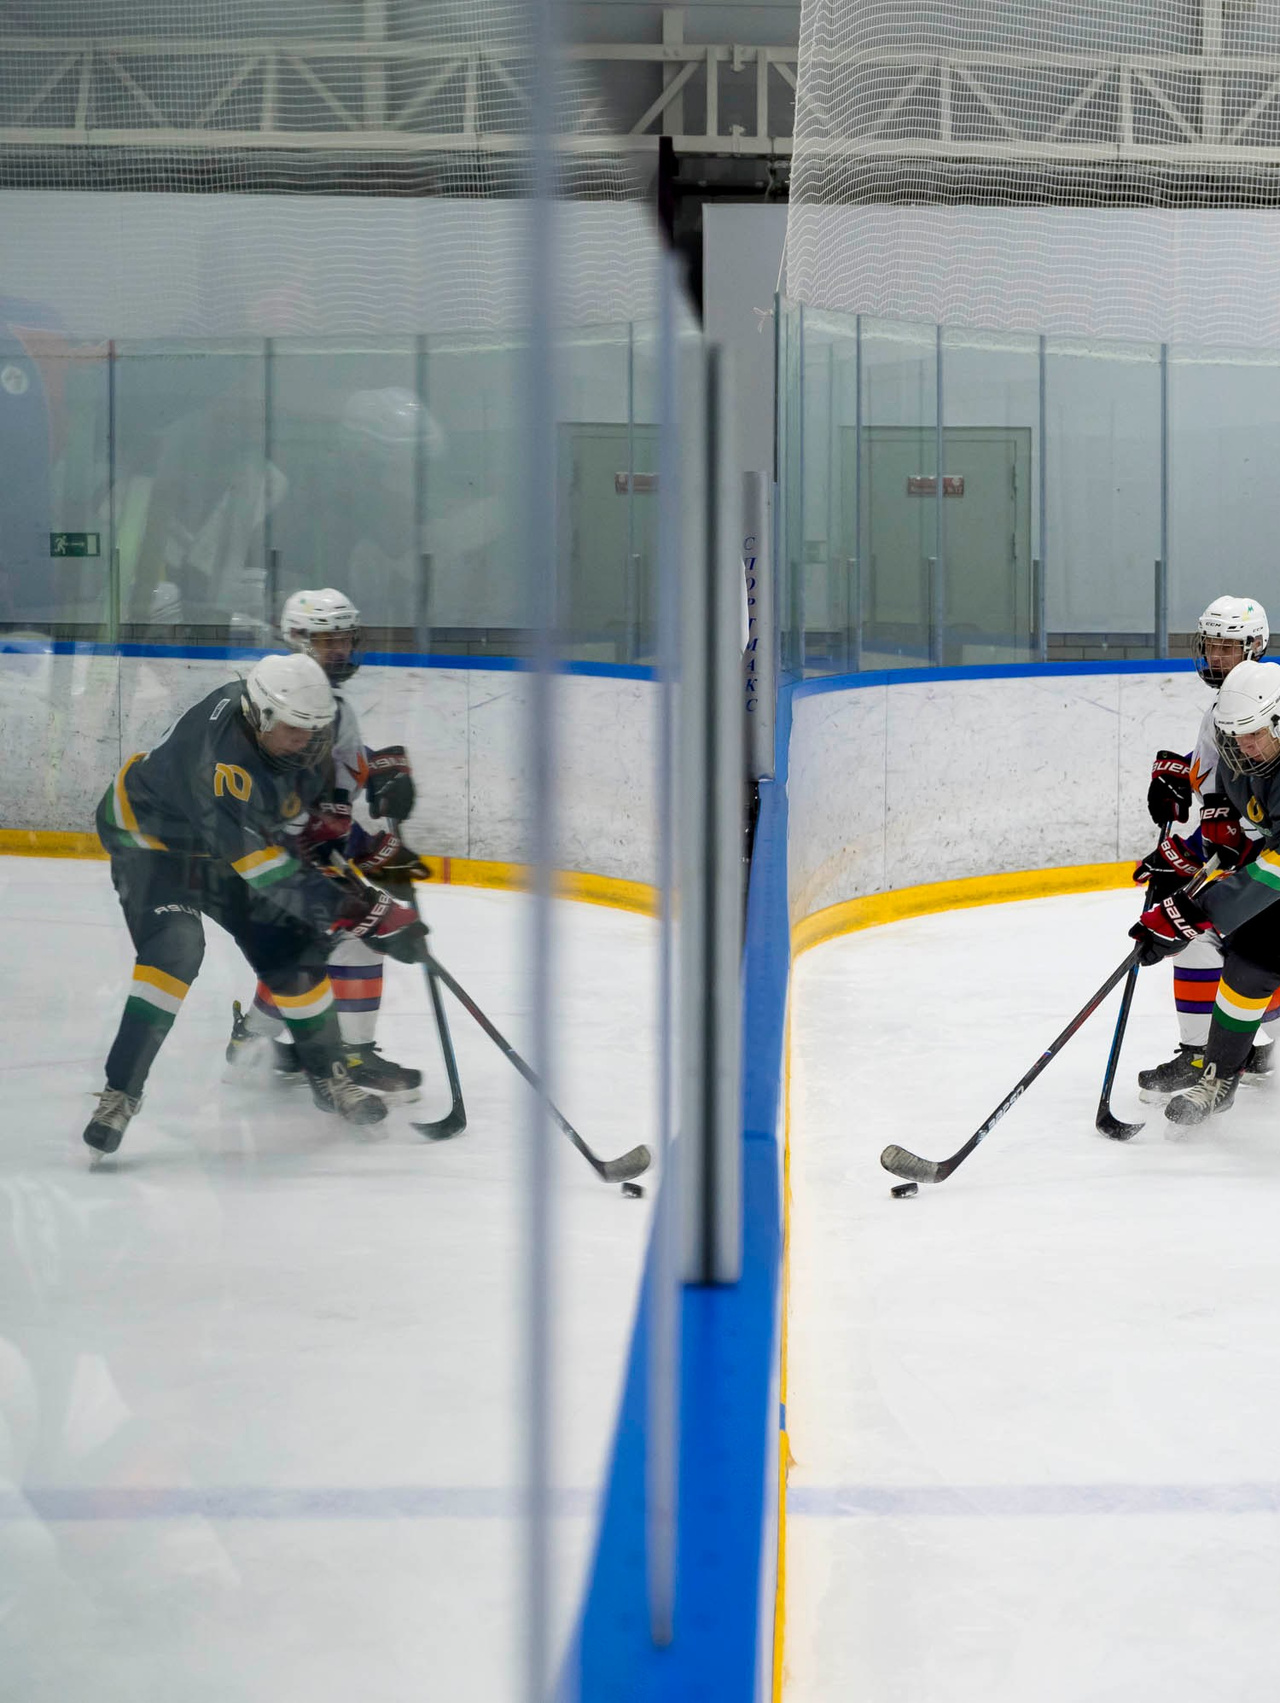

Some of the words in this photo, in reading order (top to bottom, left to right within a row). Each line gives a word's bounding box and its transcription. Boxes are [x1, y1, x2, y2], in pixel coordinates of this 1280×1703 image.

[1152, 758, 1191, 776] AUER
[1160, 839, 1200, 876] BAUE
[1163, 897, 1198, 940] BAUE
